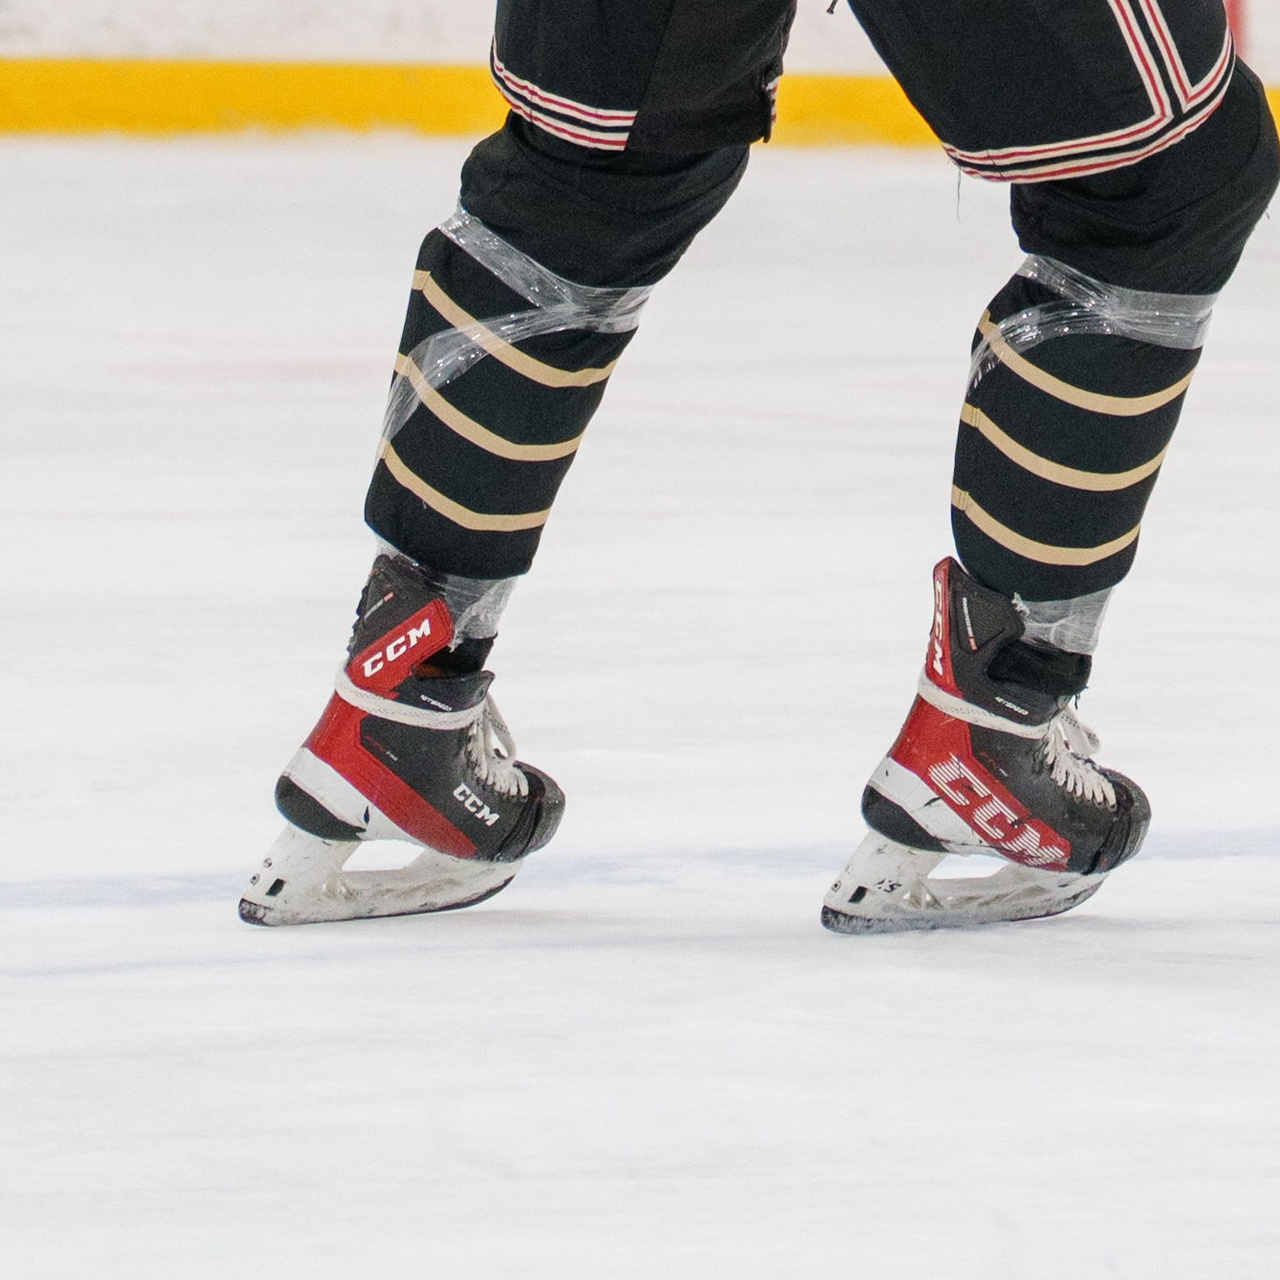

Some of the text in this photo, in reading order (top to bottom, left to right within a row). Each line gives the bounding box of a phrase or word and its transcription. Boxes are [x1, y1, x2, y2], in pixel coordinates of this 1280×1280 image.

[362, 619, 431, 678] CCM
[453, 782, 501, 828] CCM
[928, 752, 1067, 867] CCM
